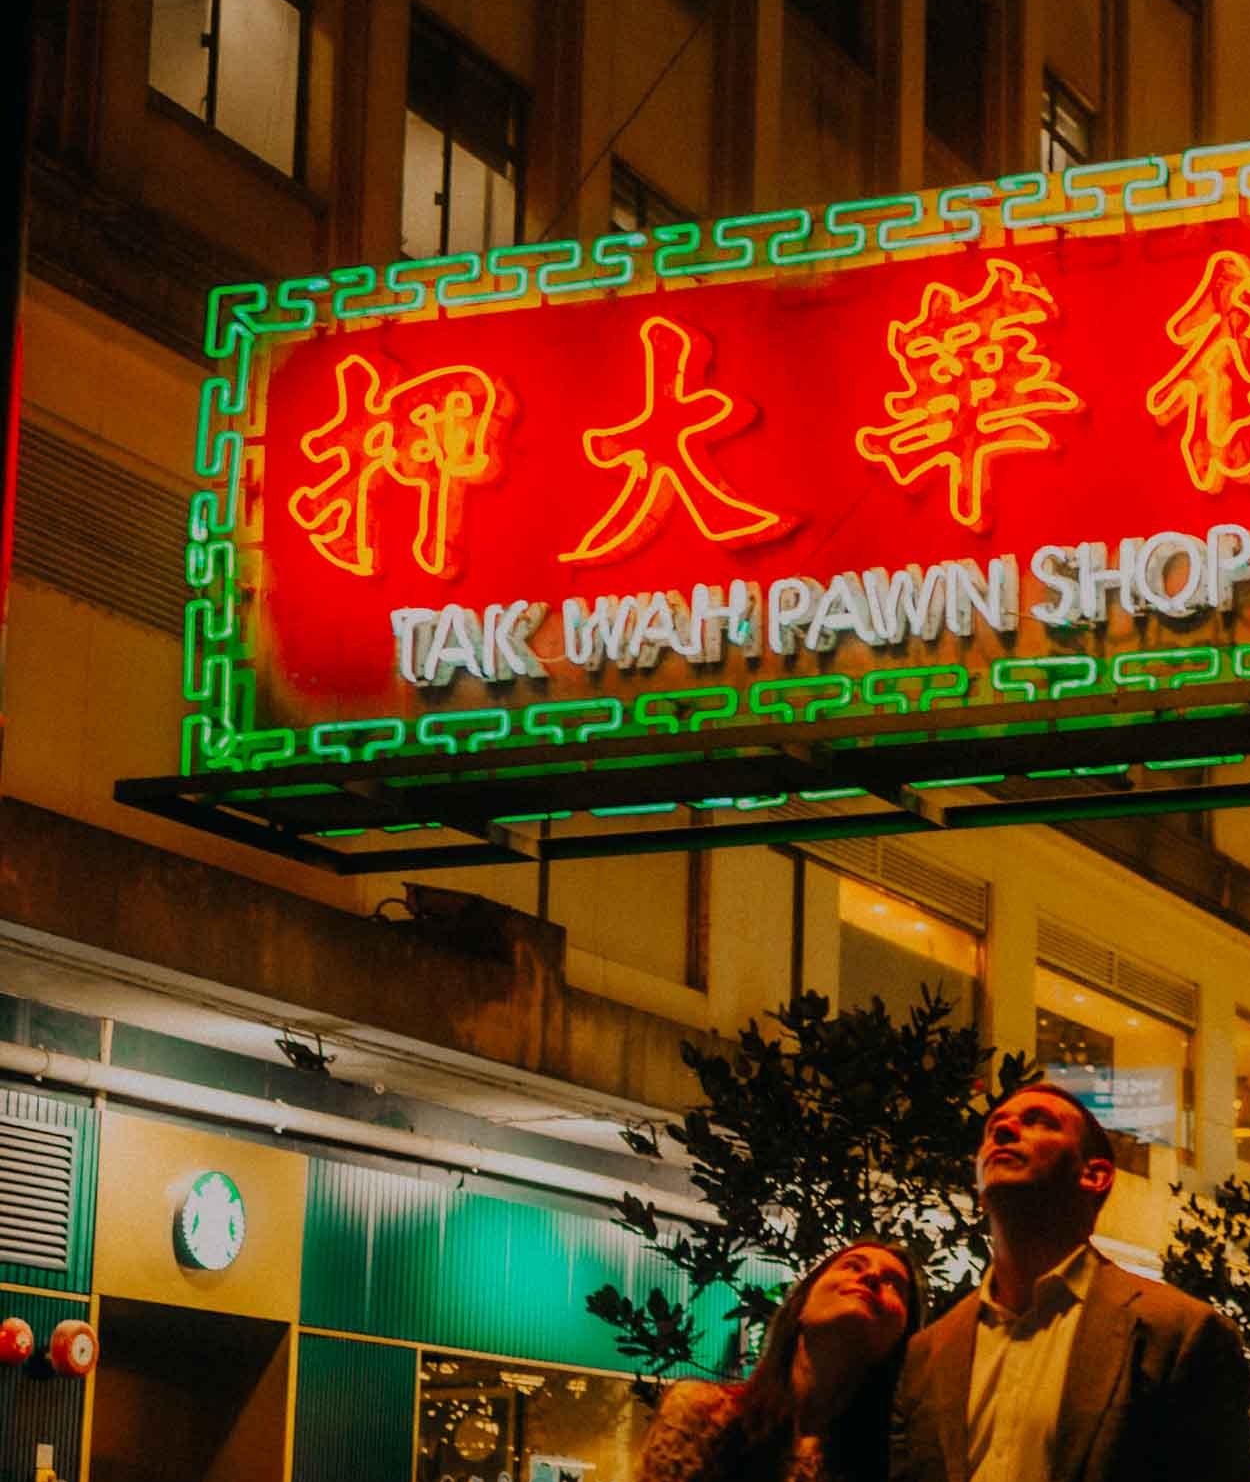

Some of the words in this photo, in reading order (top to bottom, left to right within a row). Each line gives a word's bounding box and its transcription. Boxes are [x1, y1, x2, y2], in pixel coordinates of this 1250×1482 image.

[390, 599, 544, 687] TAK
[562, 579, 760, 669] WAH
[769, 553, 1016, 656] PAWN
